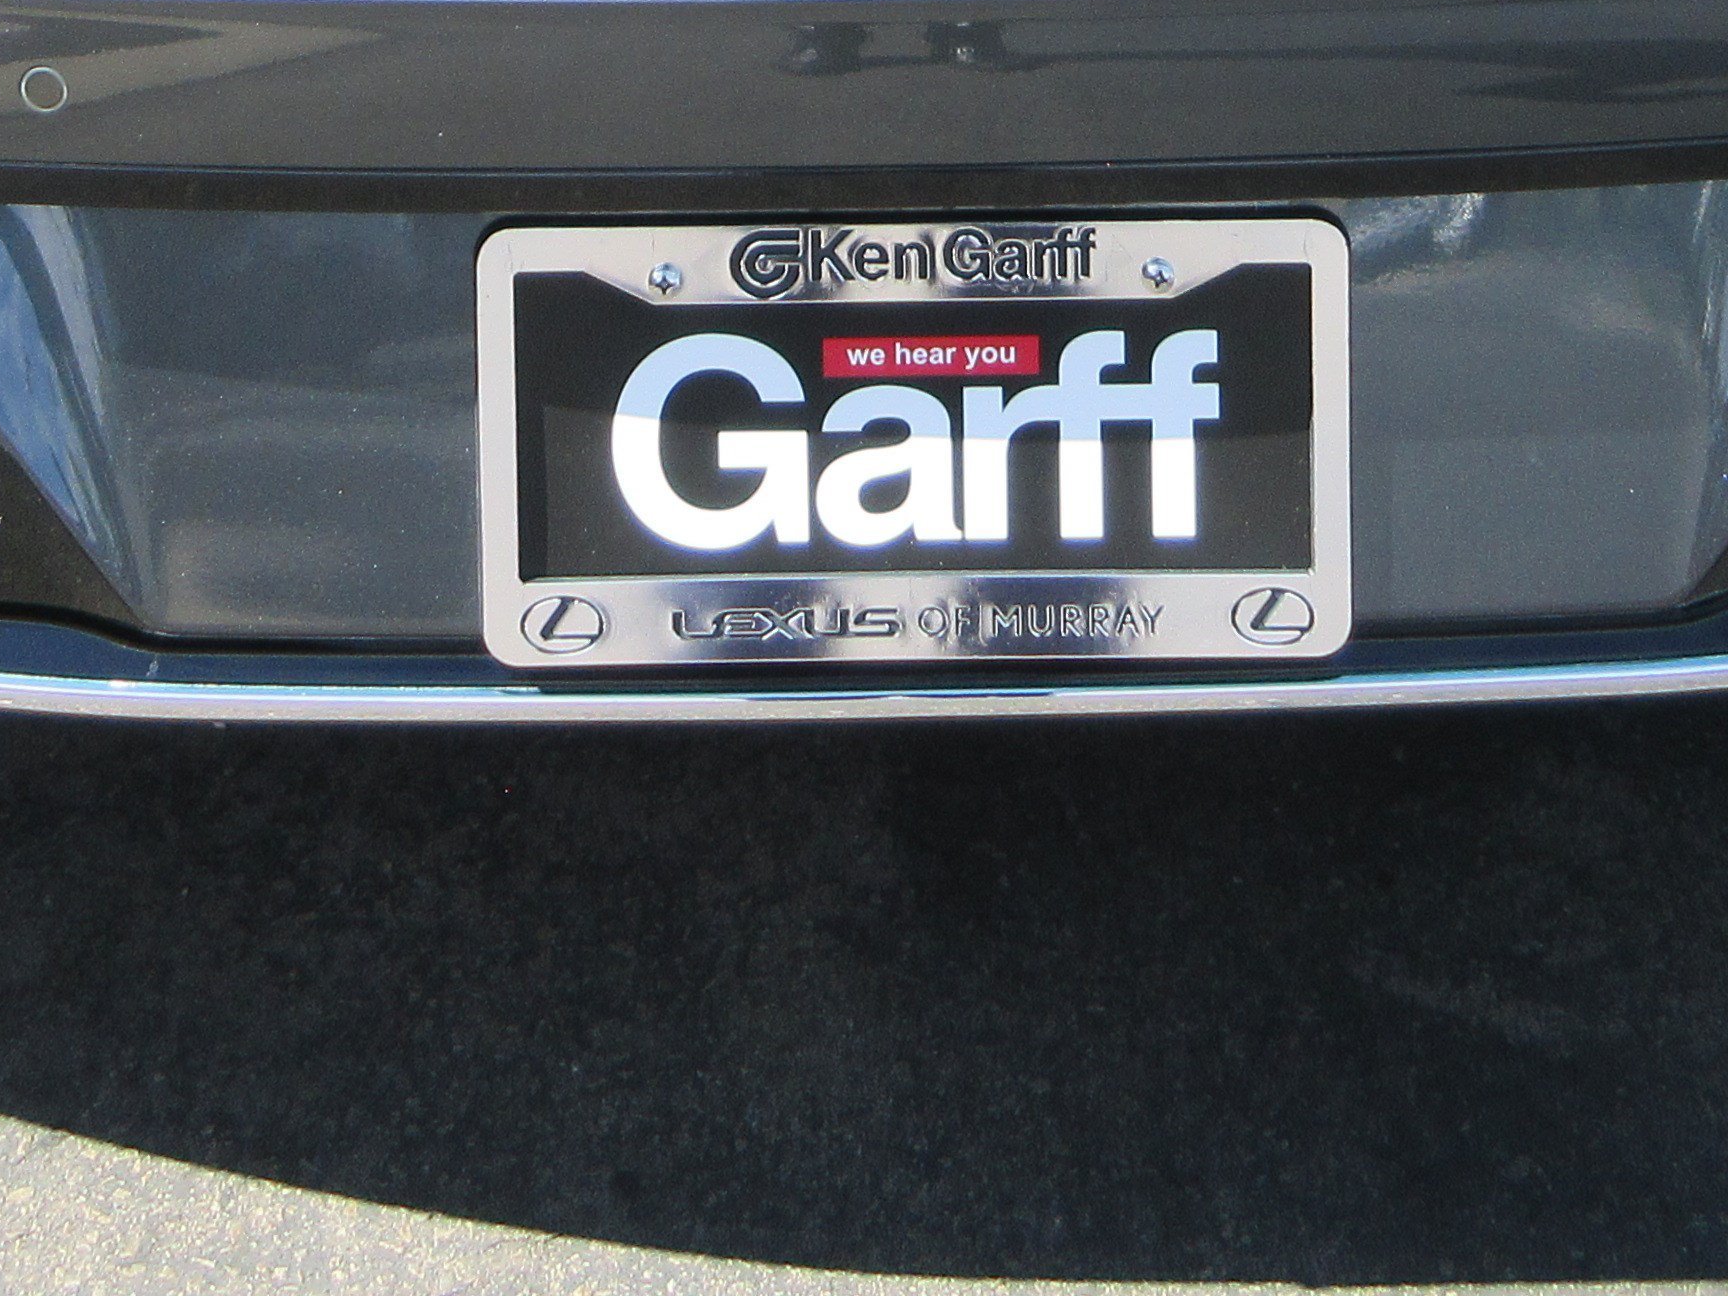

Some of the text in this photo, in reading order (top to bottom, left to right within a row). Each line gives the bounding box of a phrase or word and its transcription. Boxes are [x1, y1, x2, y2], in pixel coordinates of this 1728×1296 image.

[808, 225, 1098, 282] Ken Garff
[846, 342, 1017, 371] we hear you
[610, 328, 1221, 552] Garff
[671, 603, 1168, 641] LEXUS OF MURRAY
